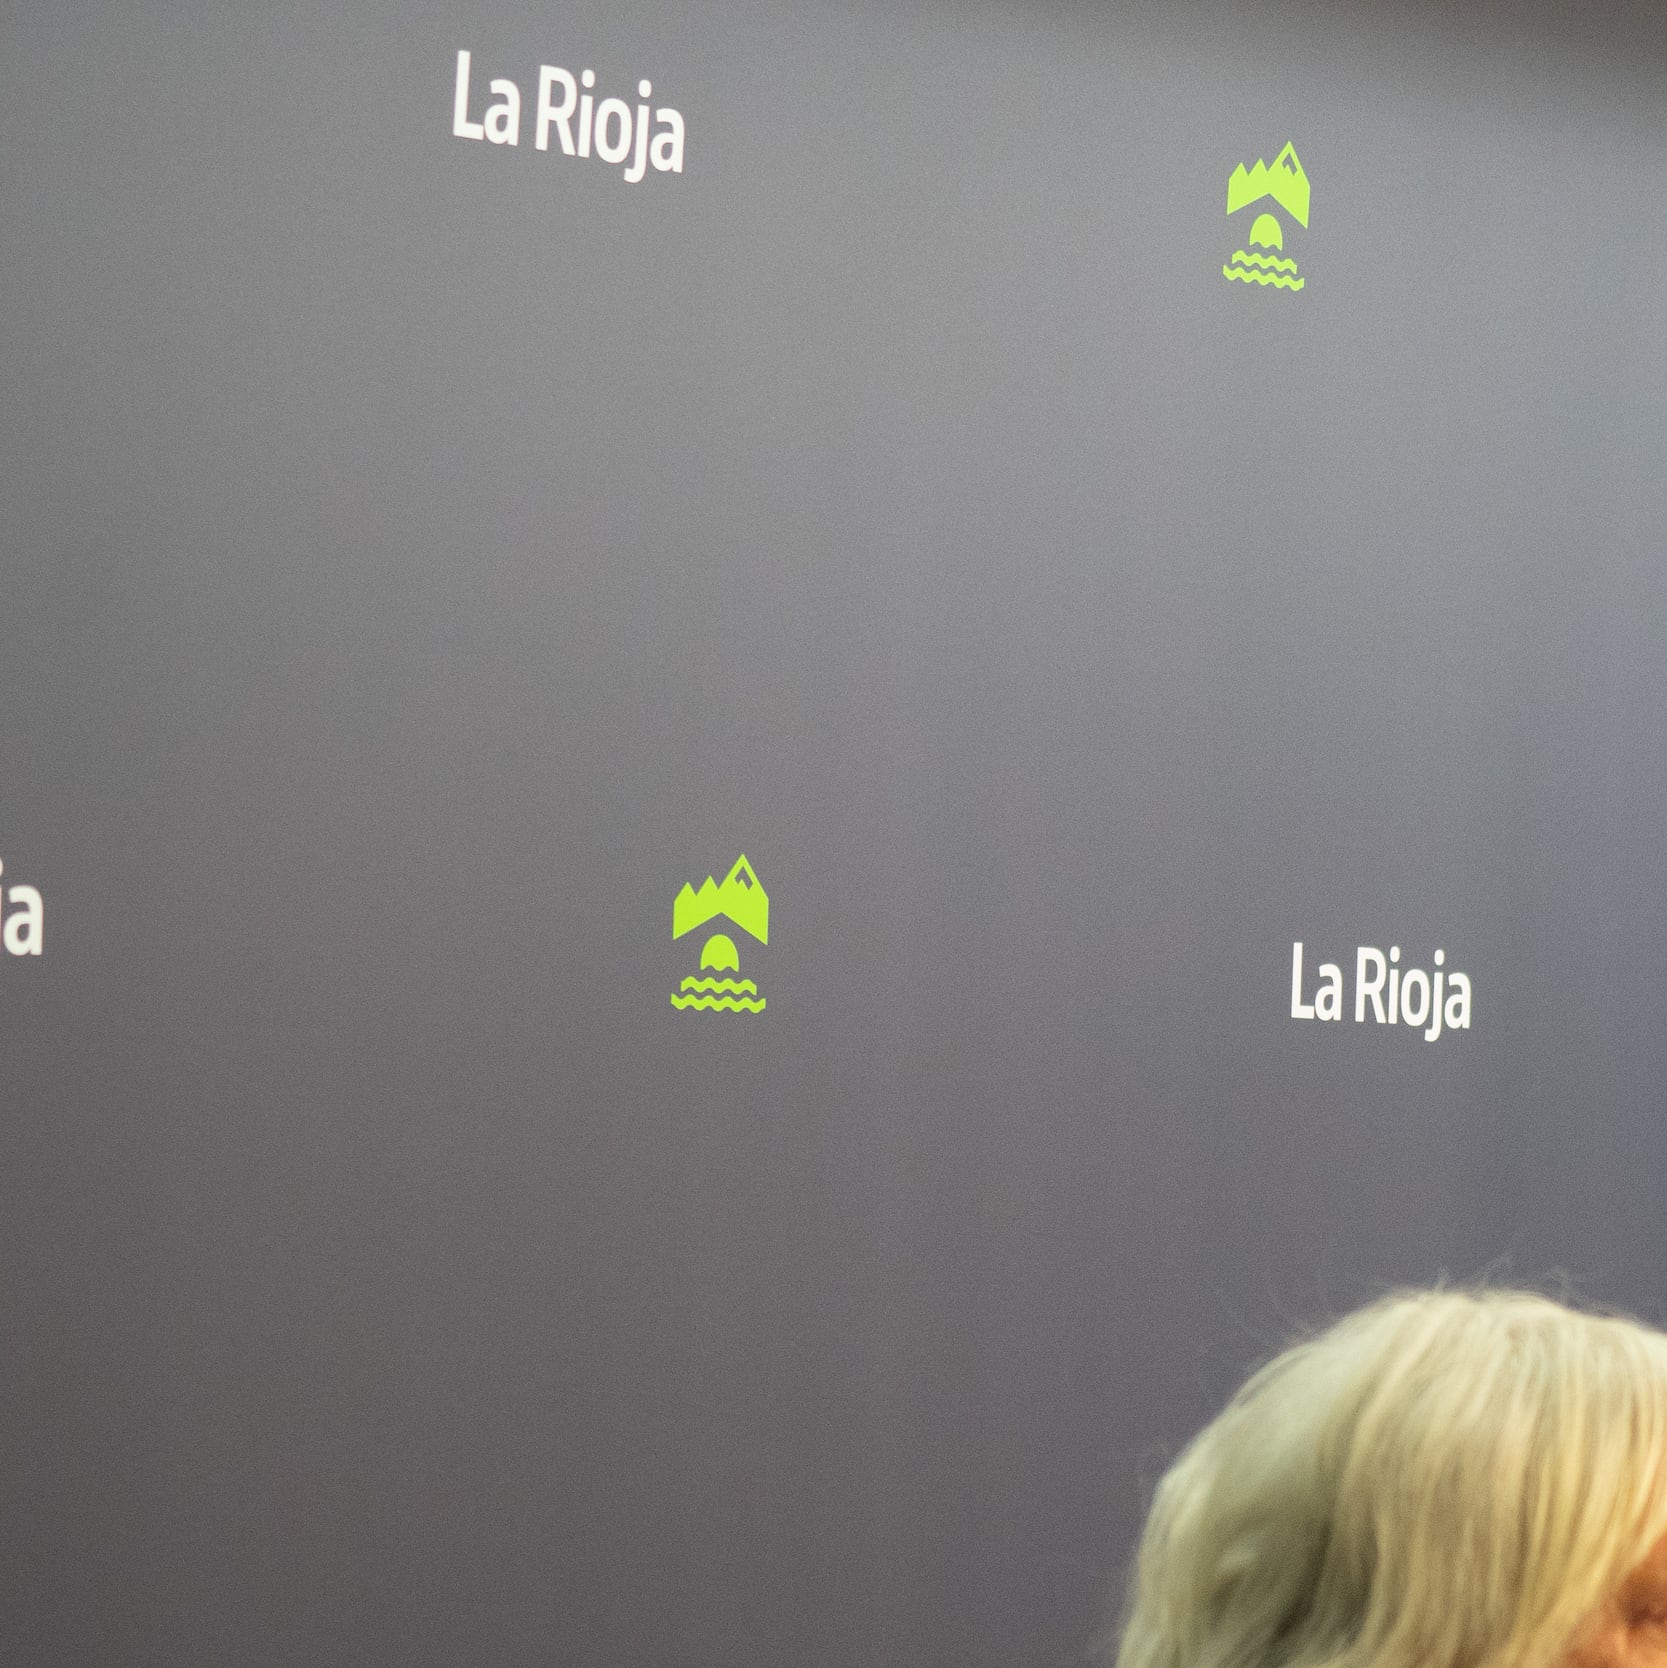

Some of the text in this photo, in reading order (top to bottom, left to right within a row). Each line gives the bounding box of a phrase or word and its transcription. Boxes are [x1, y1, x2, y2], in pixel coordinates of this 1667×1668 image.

[451, 49, 687, 184] La Rioja
[1290, 941, 1473, 1043] La Rioja
